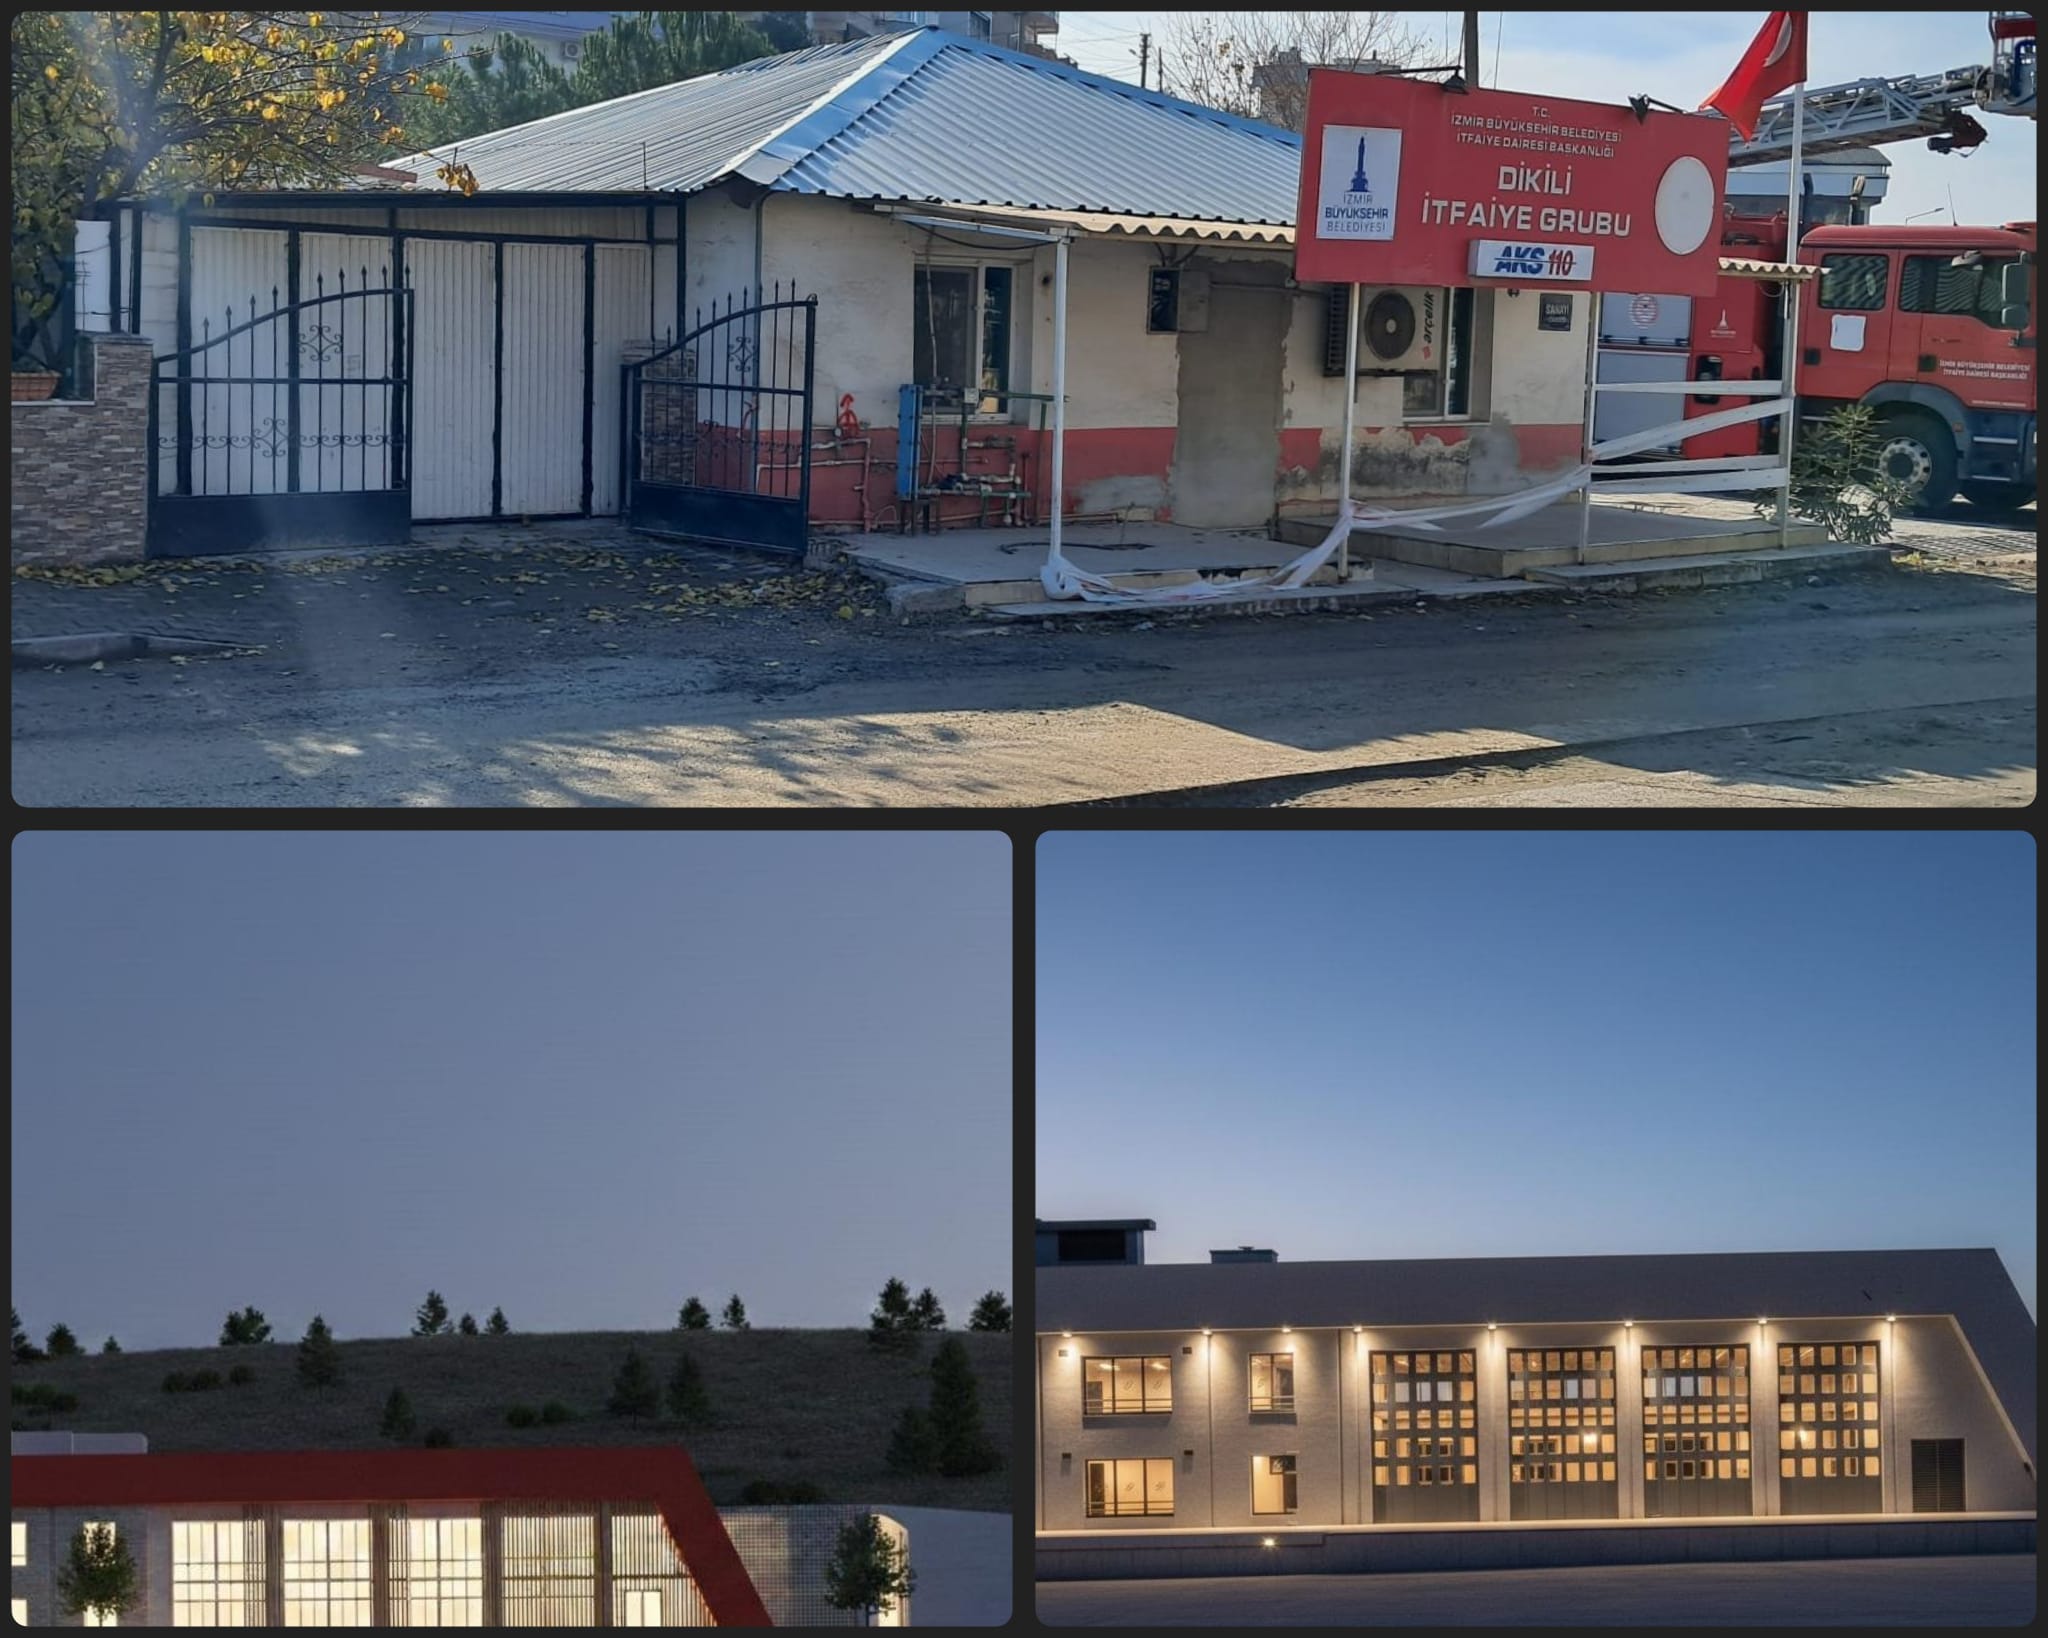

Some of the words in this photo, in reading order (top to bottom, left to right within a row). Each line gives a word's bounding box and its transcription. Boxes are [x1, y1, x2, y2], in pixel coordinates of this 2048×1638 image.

[1451, 112, 1484, 128] İZMİR
[1456, 127, 1501, 147] İTFAİYE
[1503, 136, 1548, 151] DAİRESİ
[1498, 161, 1573, 195] DİKİLİ
[1421, 191, 1534, 230] İTFAİYE
[1539, 207, 1631, 237] GRUBU
[1494, 245, 1546, 275] AKS
[1548, 249, 1575, 276] 110
[1423, 291, 1435, 344] arçelik
